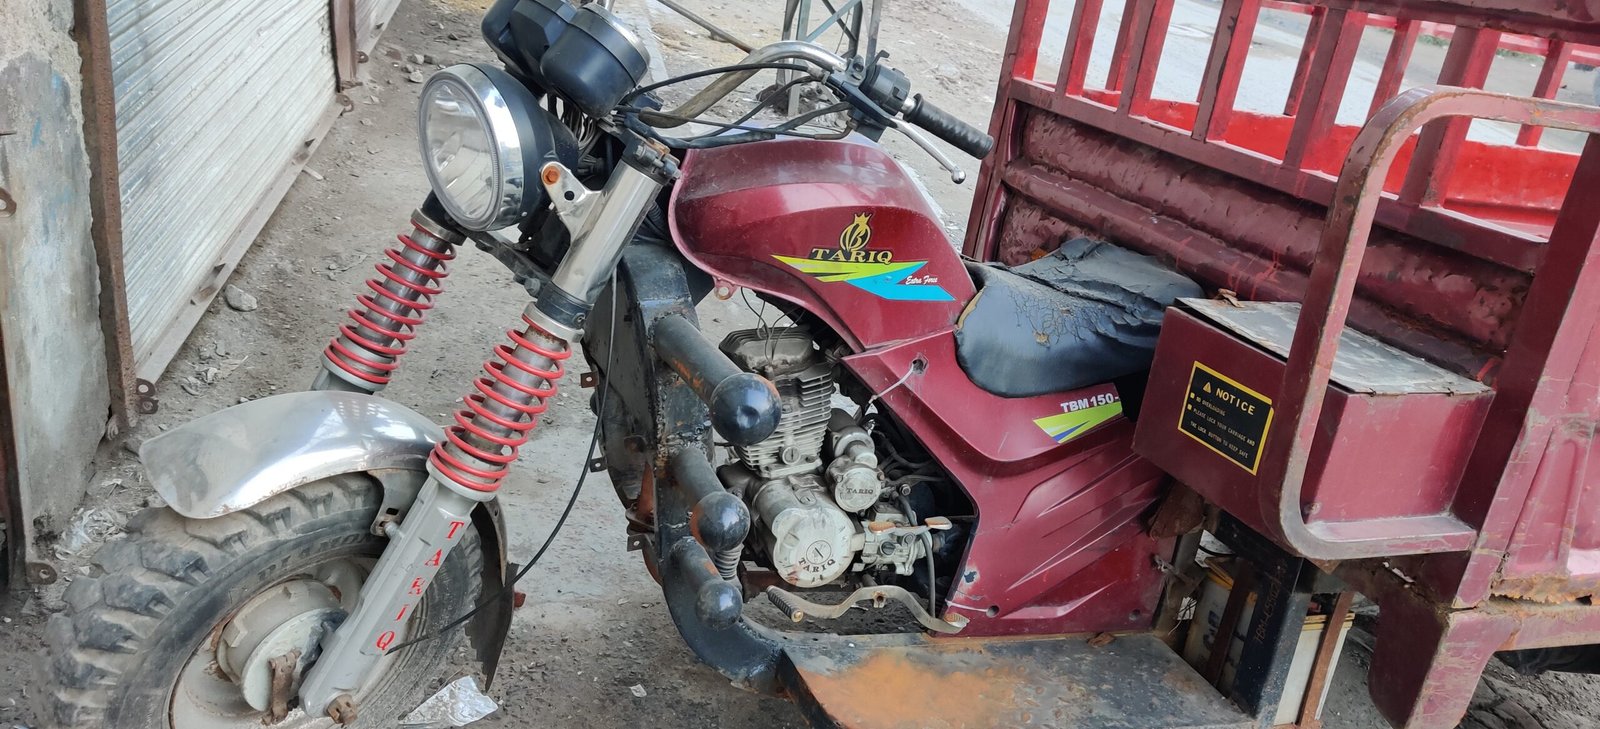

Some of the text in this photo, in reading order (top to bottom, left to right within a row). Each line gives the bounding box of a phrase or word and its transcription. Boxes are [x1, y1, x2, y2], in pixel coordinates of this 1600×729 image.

[811, 248, 893, 265] TARIQ
[1060, 398, 1089, 413] TBM
[1202, 400, 1226, 417] OVERLOADING
[1215, 387, 1256, 416] NOTICE
[1193, 408, 1256, 447] PLEASE LOCK YOUR CARRIAGE AND
[1197, 425, 1207, 435] LOCK
[1208, 431, 1222, 443] BUTTON
[1228, 443, 1238, 453] KEEP
[1239, 449, 1249, 459] SAFE
[846, 486, 874, 495] TARIQ
[798, 557, 836, 573] TARIQ
[376, 521, 464, 651] TARIQ
